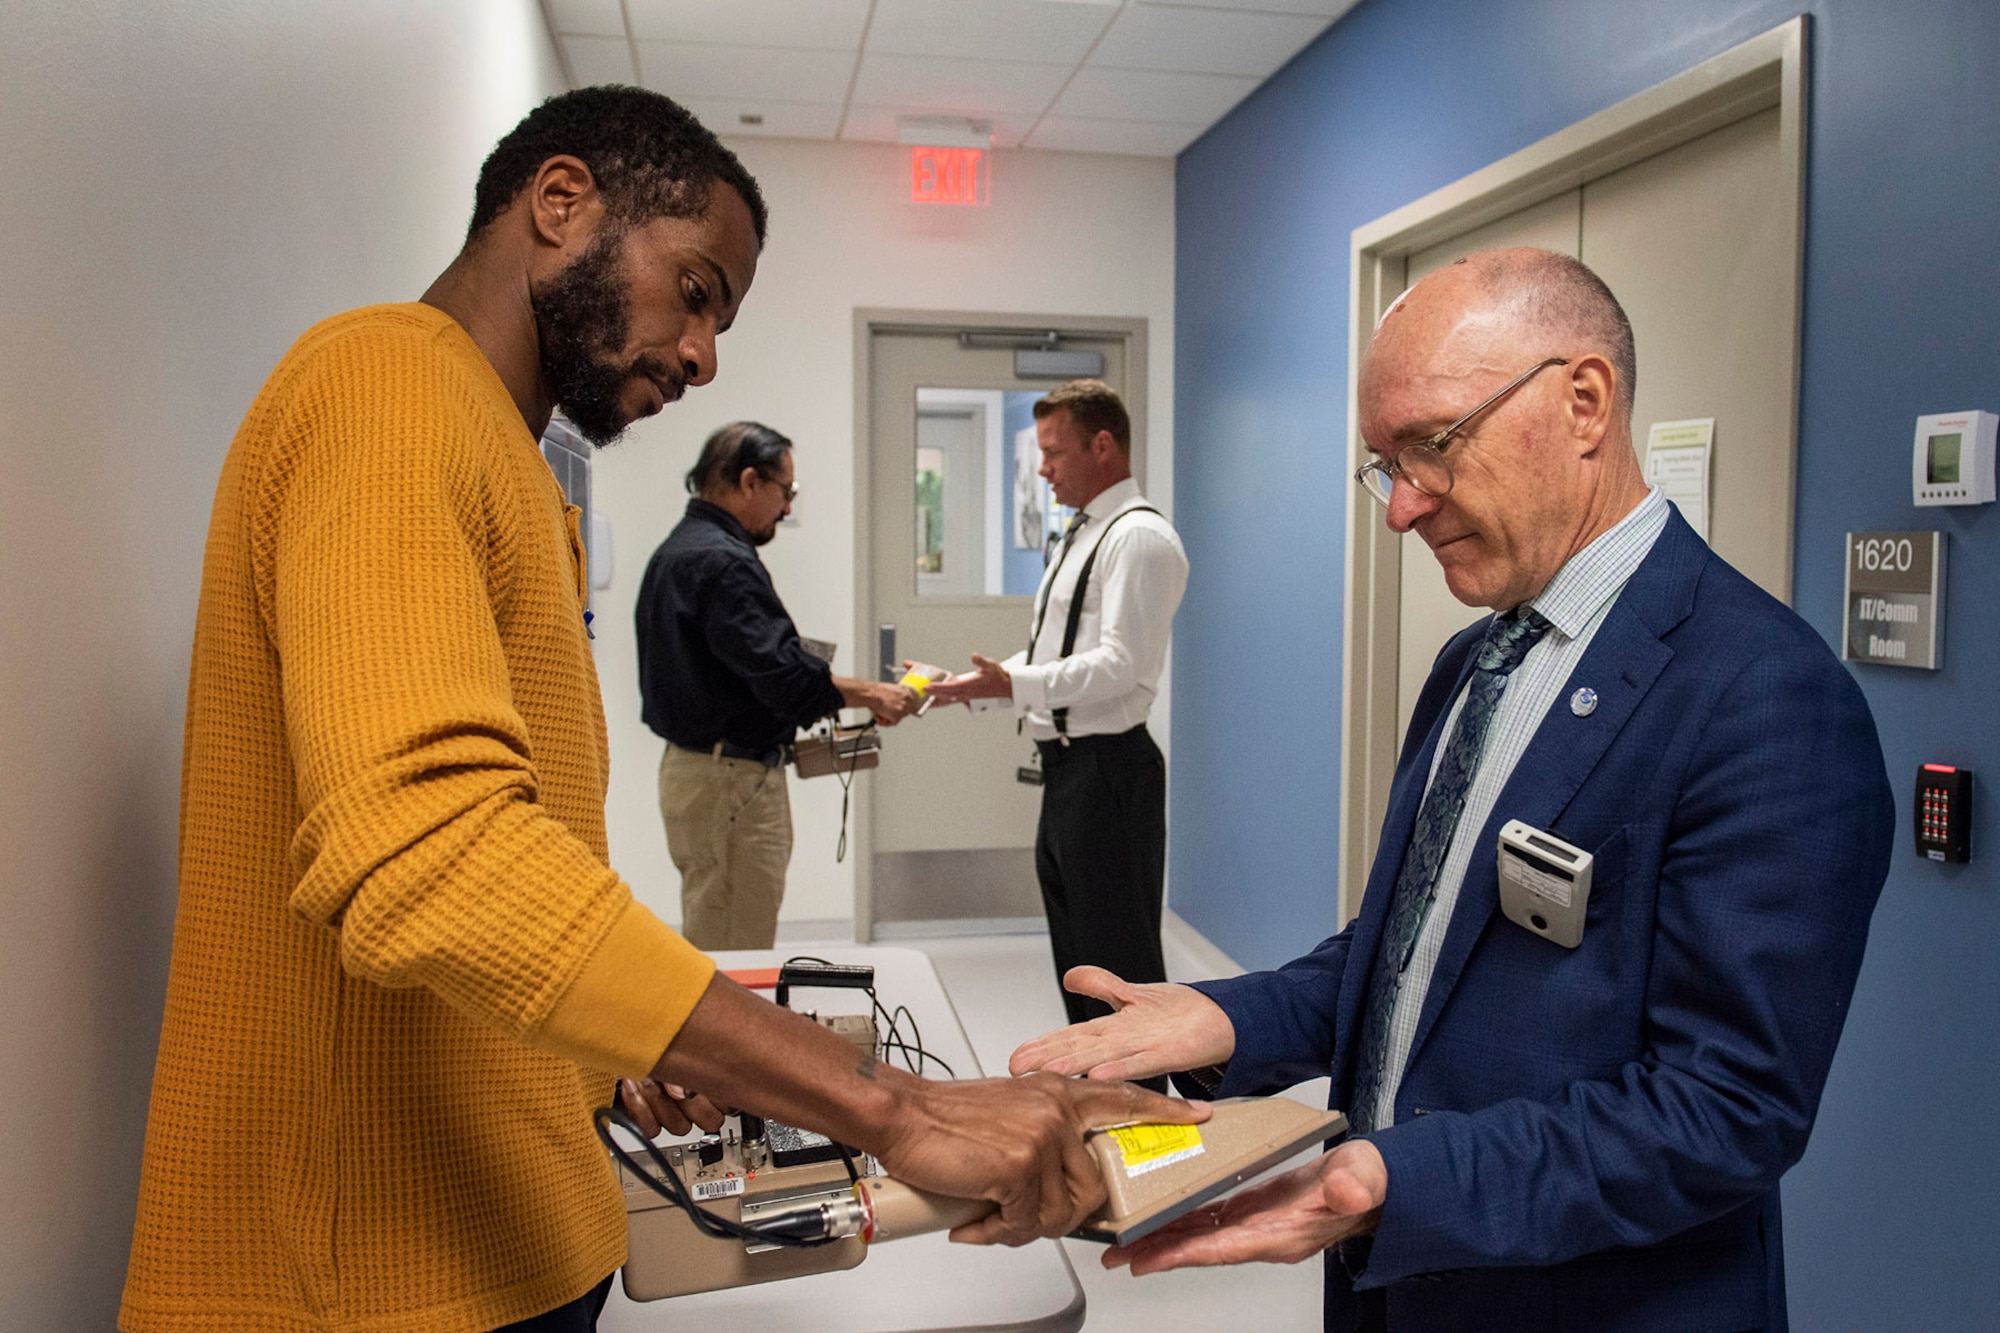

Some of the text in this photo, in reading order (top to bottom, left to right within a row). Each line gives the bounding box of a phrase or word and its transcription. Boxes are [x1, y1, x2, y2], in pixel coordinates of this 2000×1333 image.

[912, 146, 981, 203] EXIT
[1855, 538, 1912, 571] 1620
[1860, 599, 1918, 623] IT/Comm
[1869, 635, 1906, 658] Room
